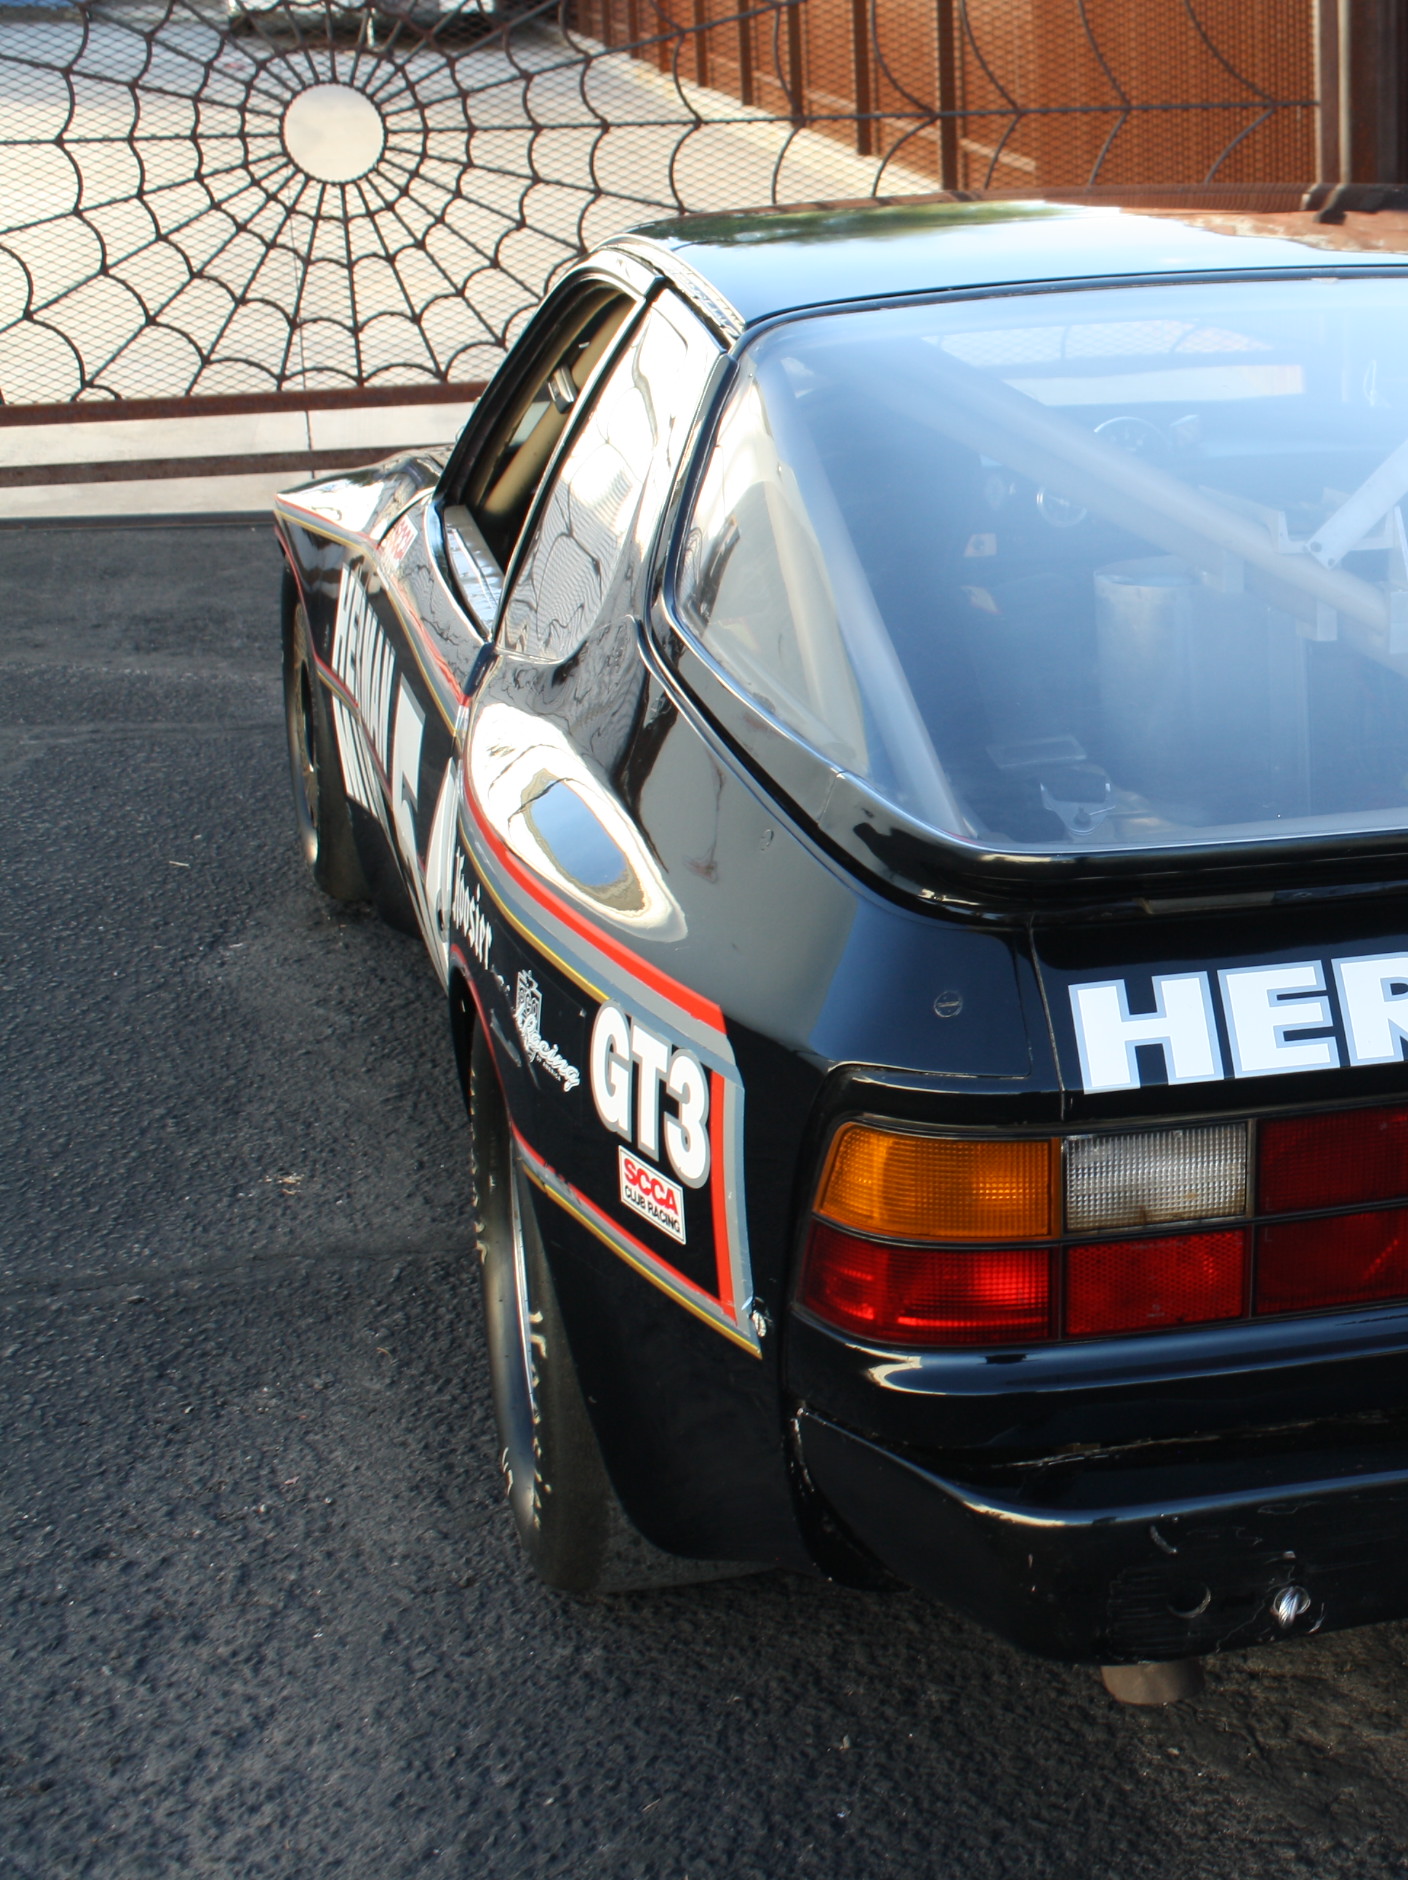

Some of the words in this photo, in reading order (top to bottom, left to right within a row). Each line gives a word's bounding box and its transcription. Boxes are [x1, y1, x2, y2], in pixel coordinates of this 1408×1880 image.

[591, 1000, 711, 1189] GT3
[623, 1157, 679, 1216] SCCA
[624, 1184, 647, 1210] CLUB
[647, 1199, 681, 1234] RACING
